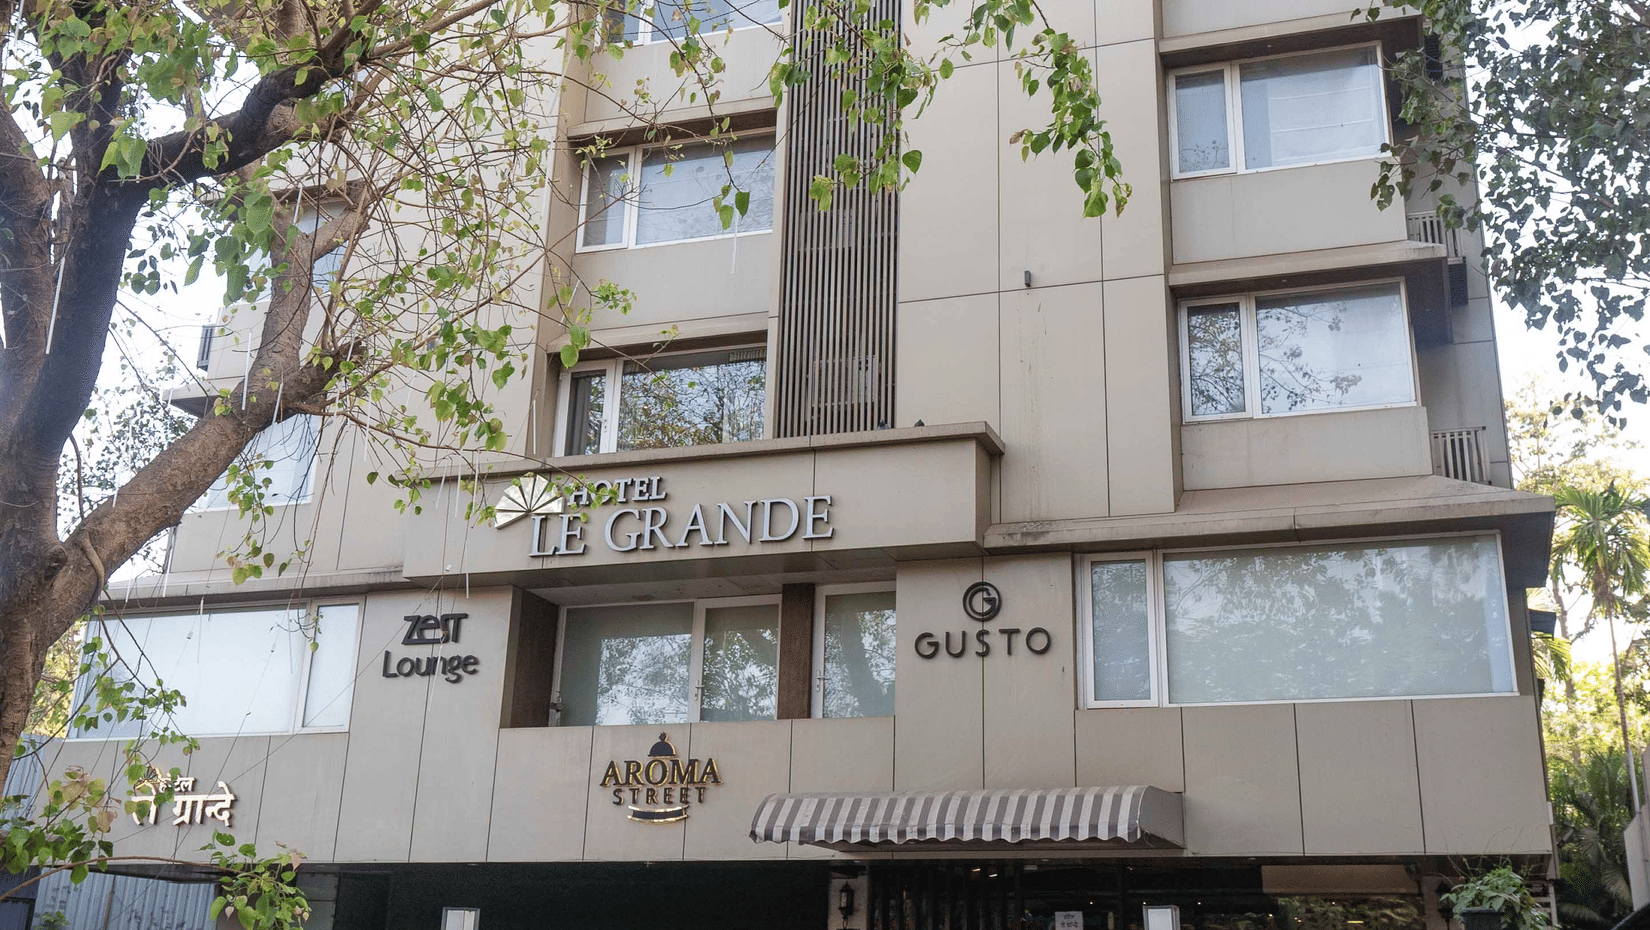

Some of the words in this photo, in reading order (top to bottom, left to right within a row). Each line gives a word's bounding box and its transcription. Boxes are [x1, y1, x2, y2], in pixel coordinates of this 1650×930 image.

[567, 476, 667, 506] HOTEL
[528, 514, 587, 558] LE
[604, 495, 835, 552] GRANDE
[914, 627, 1051, 659] GUSTO
[382, 650, 480, 684] Lounge
[599, 758, 722, 787] AROMA
[612, 786, 707, 805] STREET
